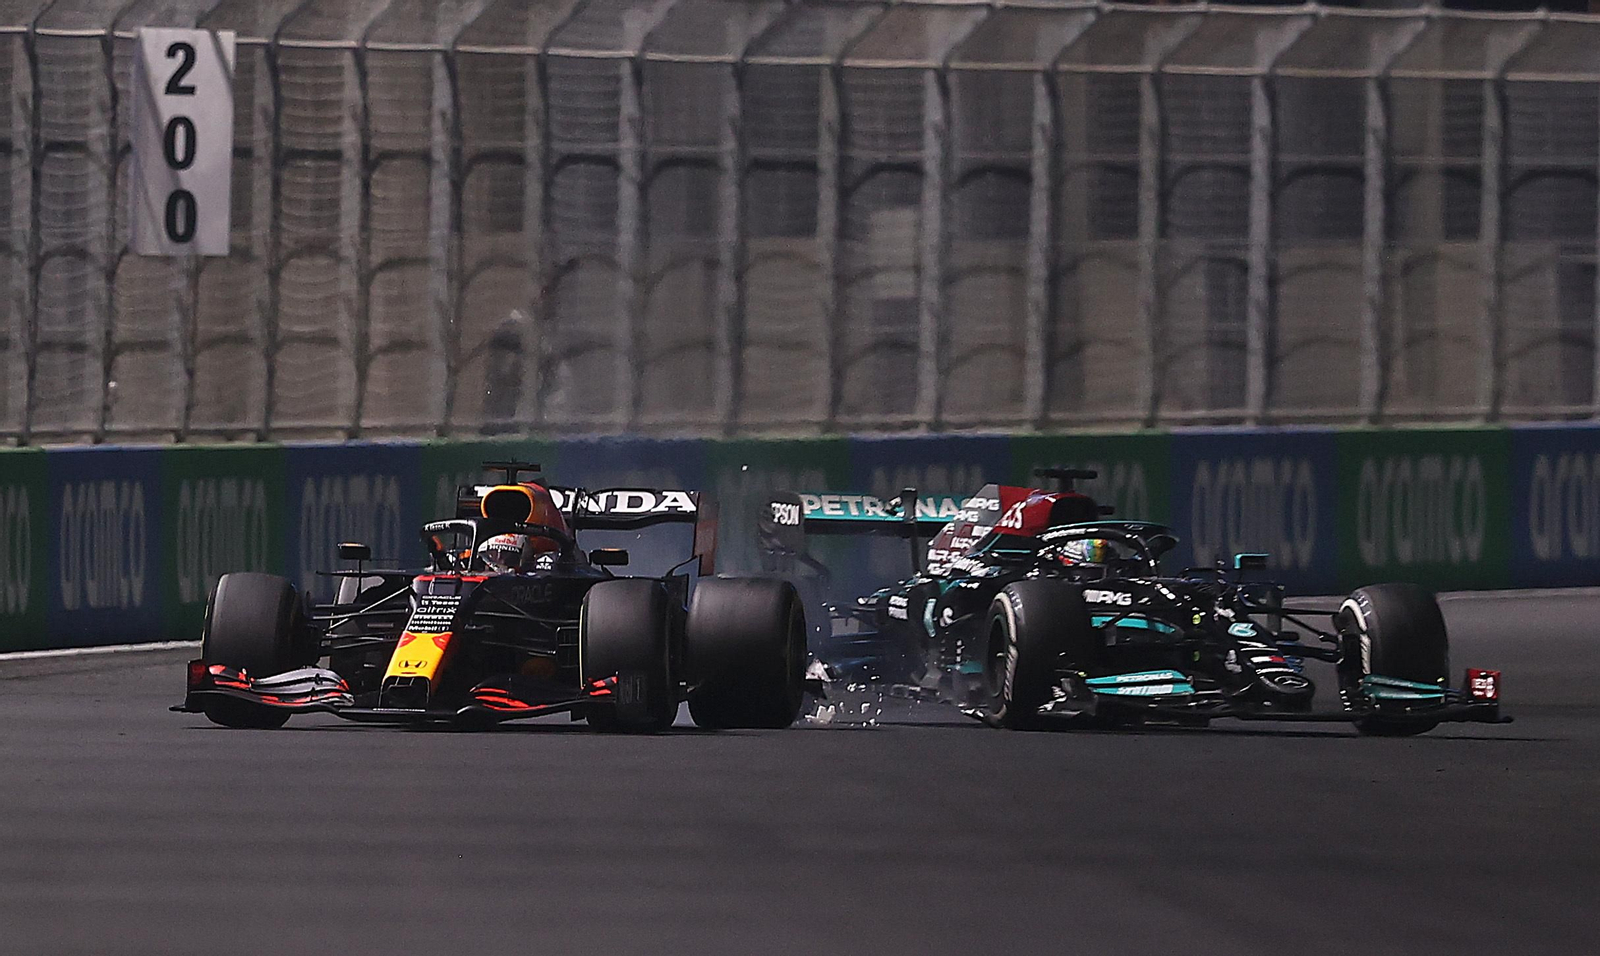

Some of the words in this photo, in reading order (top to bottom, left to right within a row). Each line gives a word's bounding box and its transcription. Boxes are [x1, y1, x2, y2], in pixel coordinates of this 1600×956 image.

[163, 42, 197, 244] 200
[474, 486, 697, 513] NDA
[799, 493, 971, 518] PETRNA
